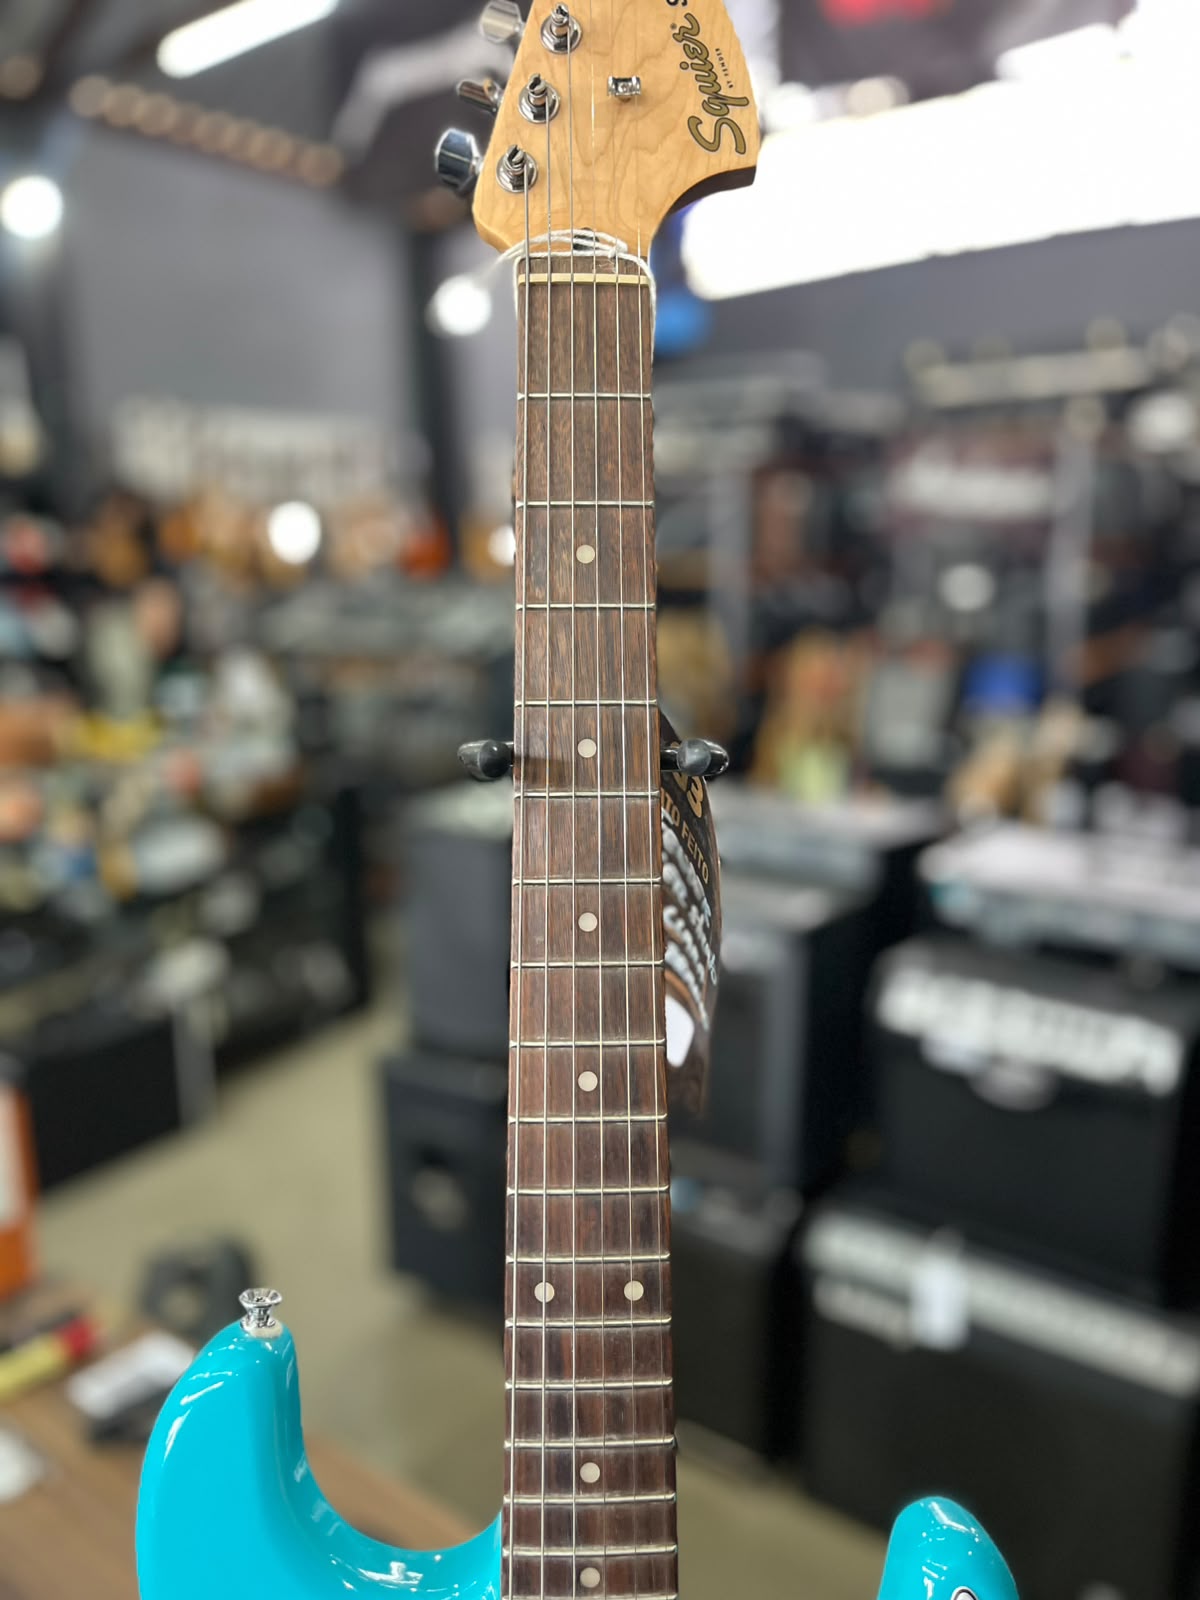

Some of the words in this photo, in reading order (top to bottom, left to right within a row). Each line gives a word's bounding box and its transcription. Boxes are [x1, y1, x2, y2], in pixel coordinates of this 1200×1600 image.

[672, 12, 750, 155] Squier
[715, 48, 729, 77] FENDER
[681, 820, 709, 885] FEITO
